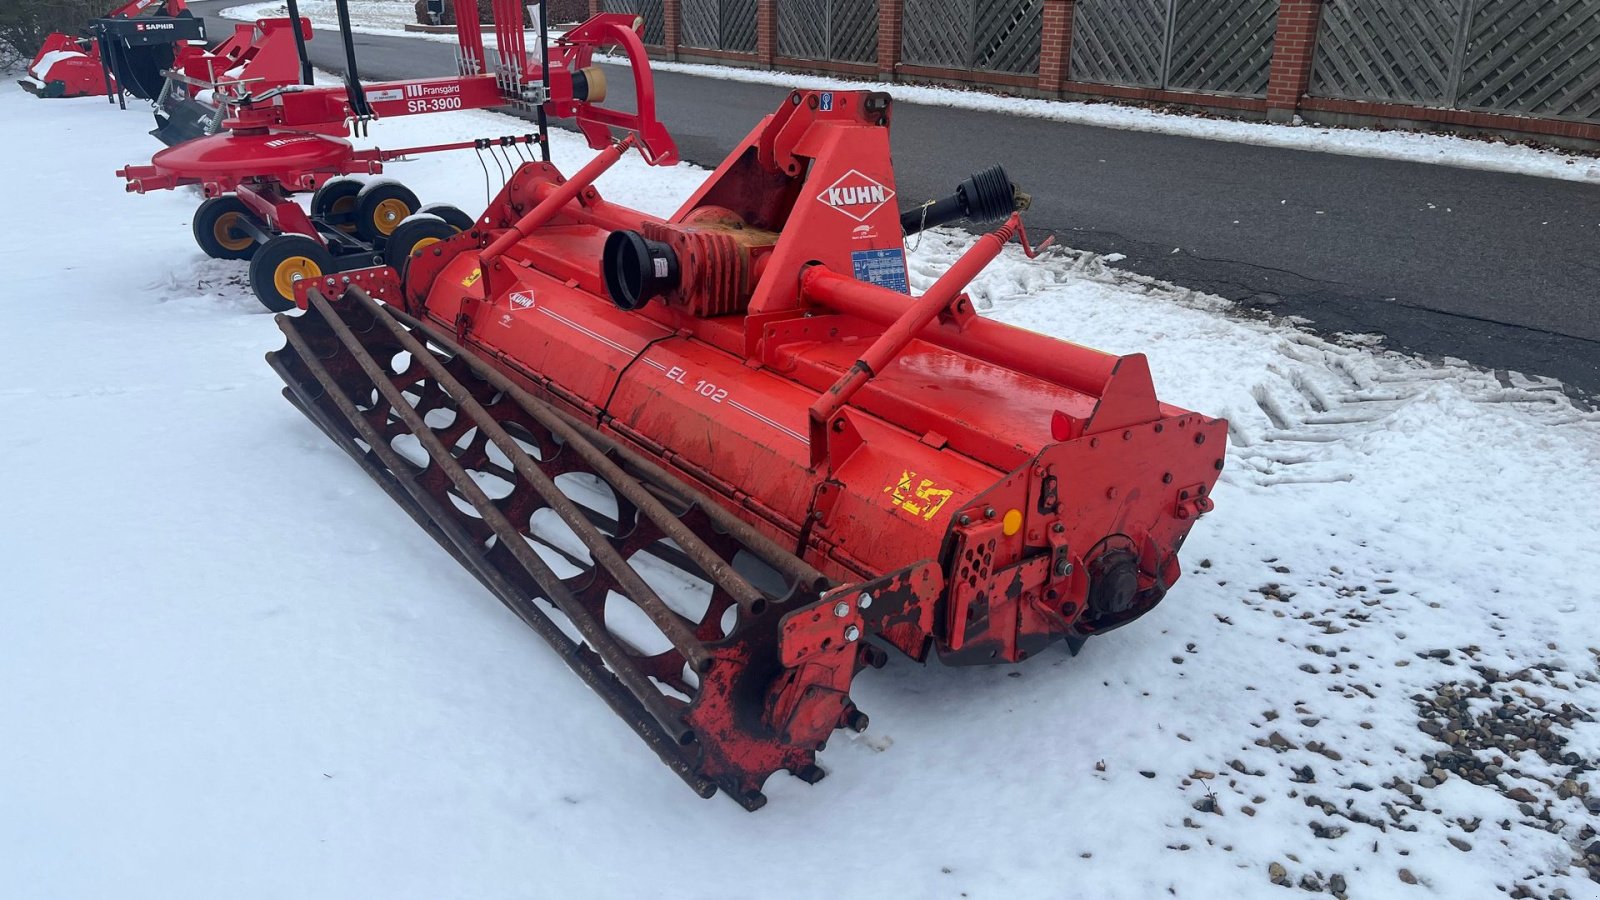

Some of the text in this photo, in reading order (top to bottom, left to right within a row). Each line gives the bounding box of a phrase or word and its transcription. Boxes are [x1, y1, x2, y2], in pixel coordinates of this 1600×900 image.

[423, 84, 460, 95] Fransgård
[407, 97, 462, 113] SR-3900
[828, 185, 885, 206] KUHN
[511, 292, 532, 308] KUHN
[665, 366, 729, 403] EL 102
